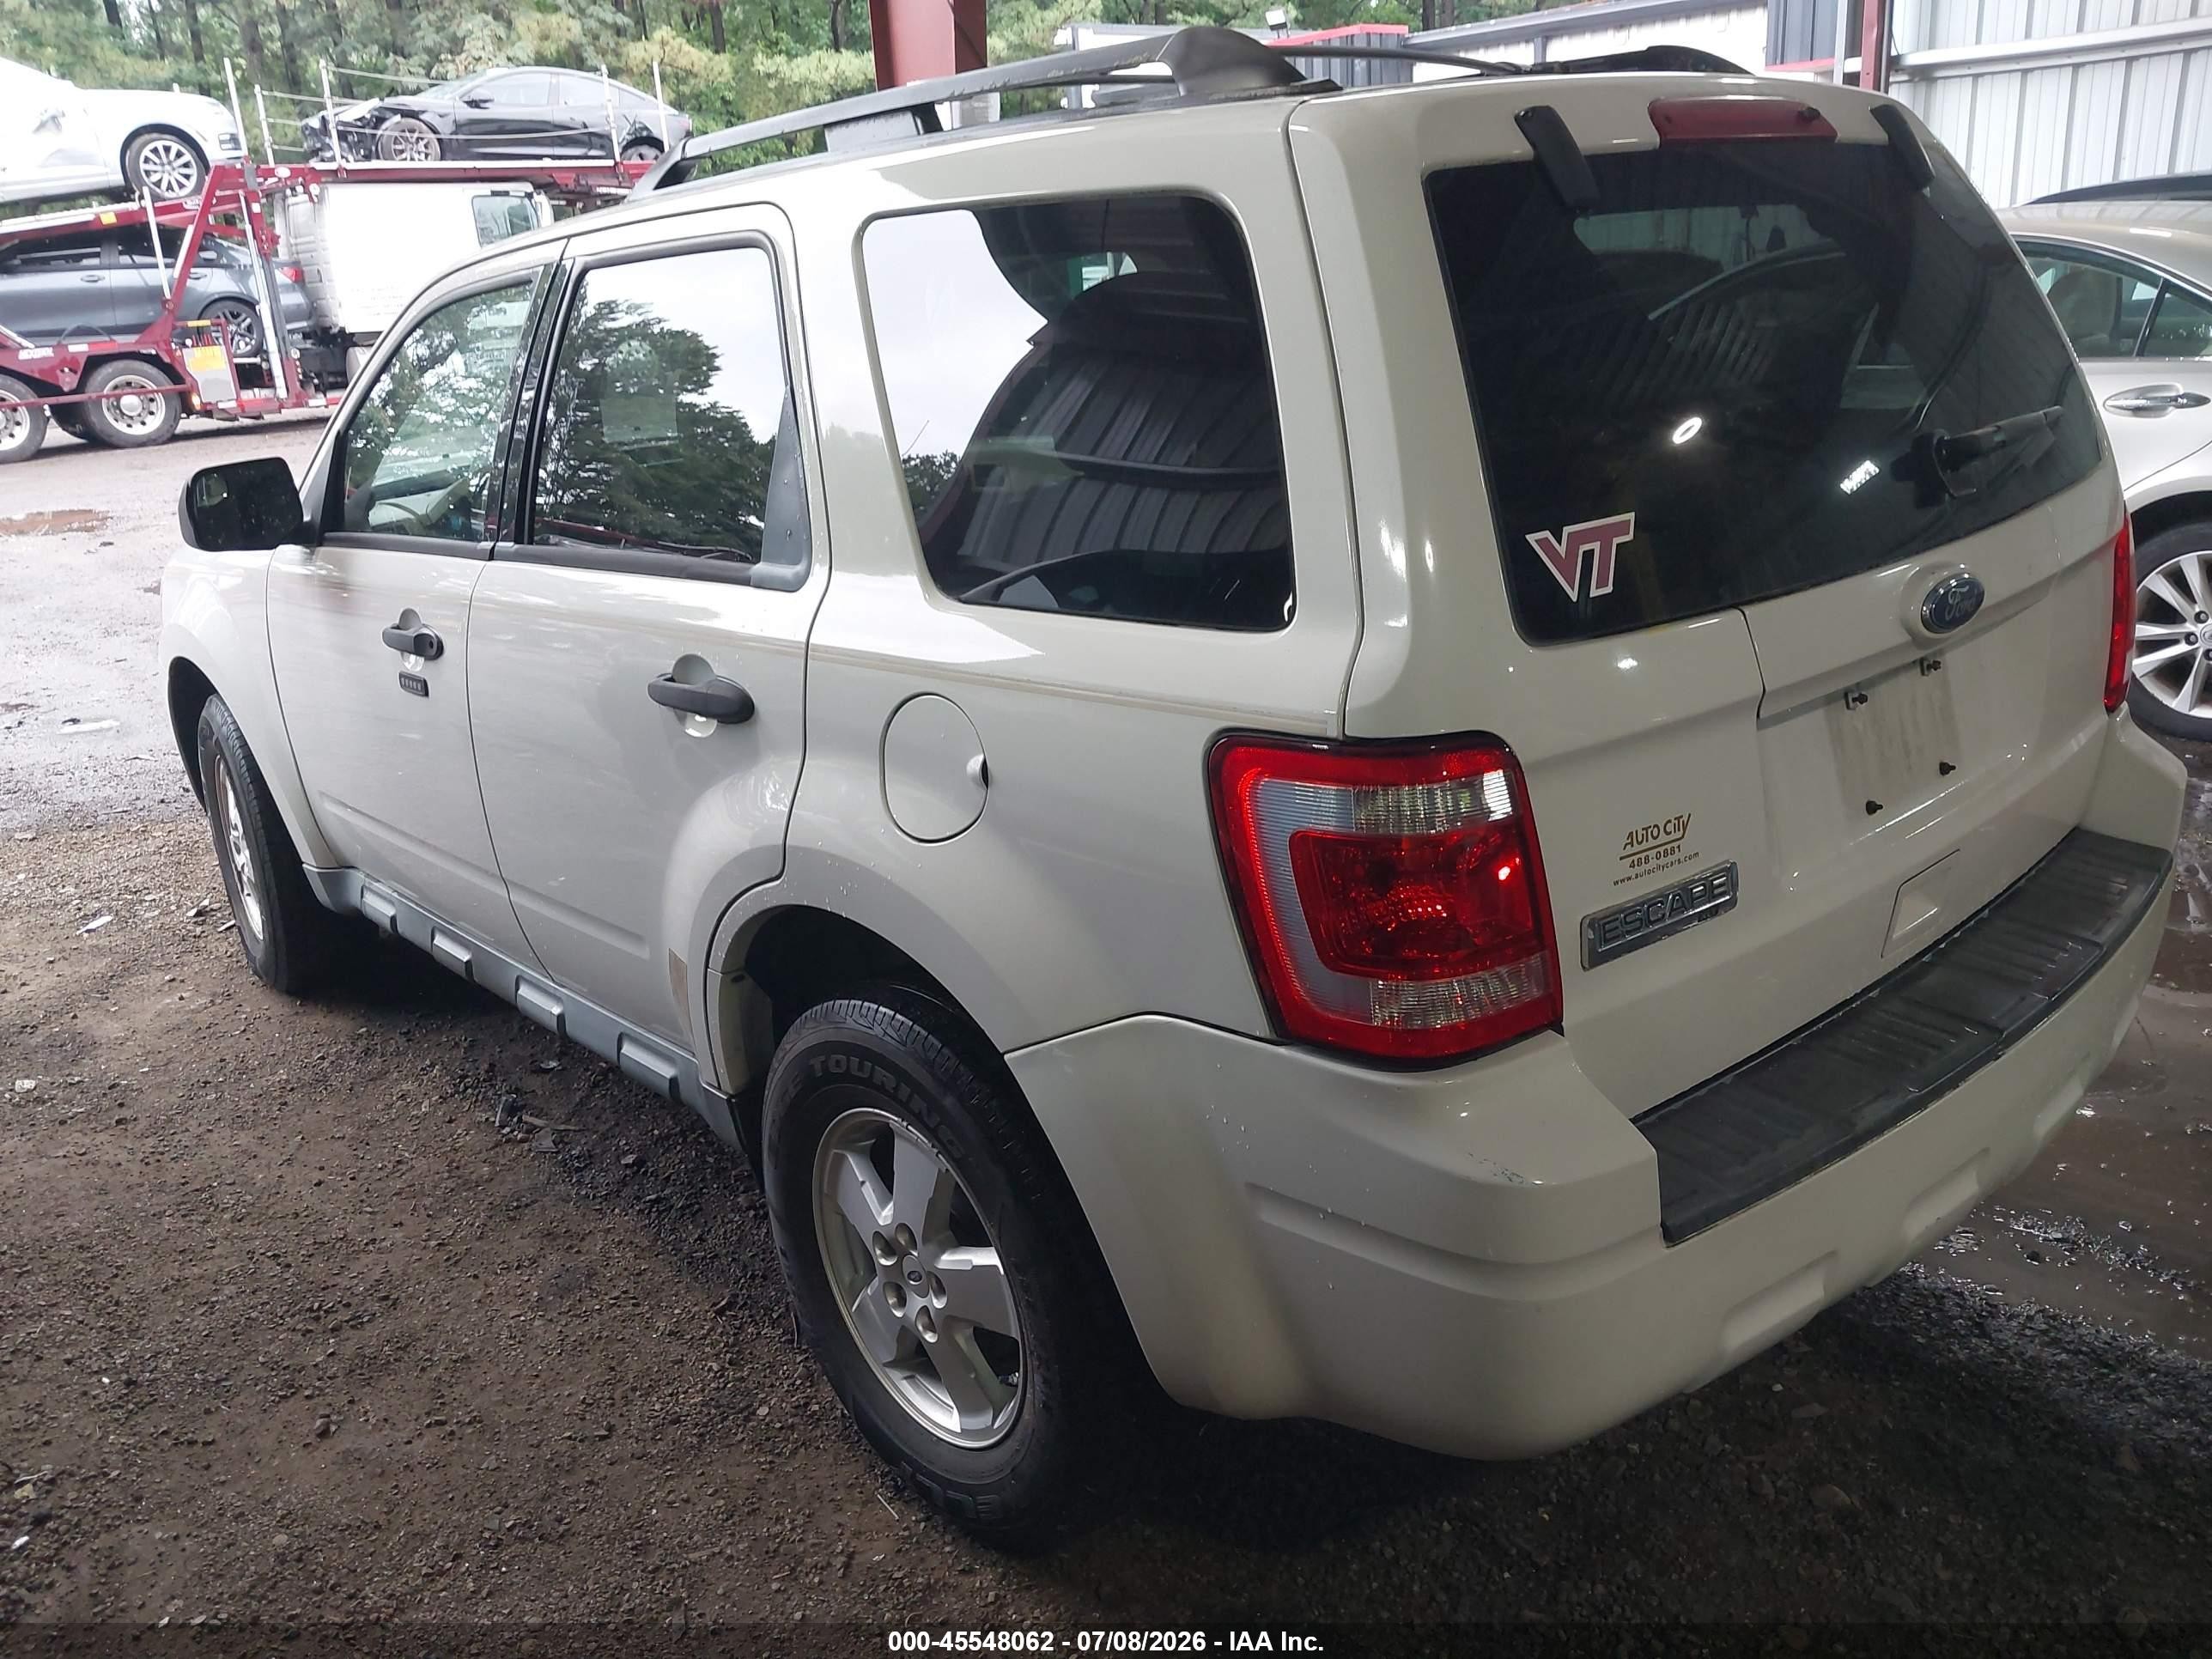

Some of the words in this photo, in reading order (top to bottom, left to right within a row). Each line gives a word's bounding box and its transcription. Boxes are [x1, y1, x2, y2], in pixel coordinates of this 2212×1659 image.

[1525, 512, 1635, 602] VT
[1623, 823, 1661, 851] AUTO
[1628, 844, 1681, 869] 488-0881
[1613, 851, 1699, 886] www.autocitycars.com
[1600, 872, 1729, 948] ESCAPE
[811, 1054, 963, 1159] TOURING
